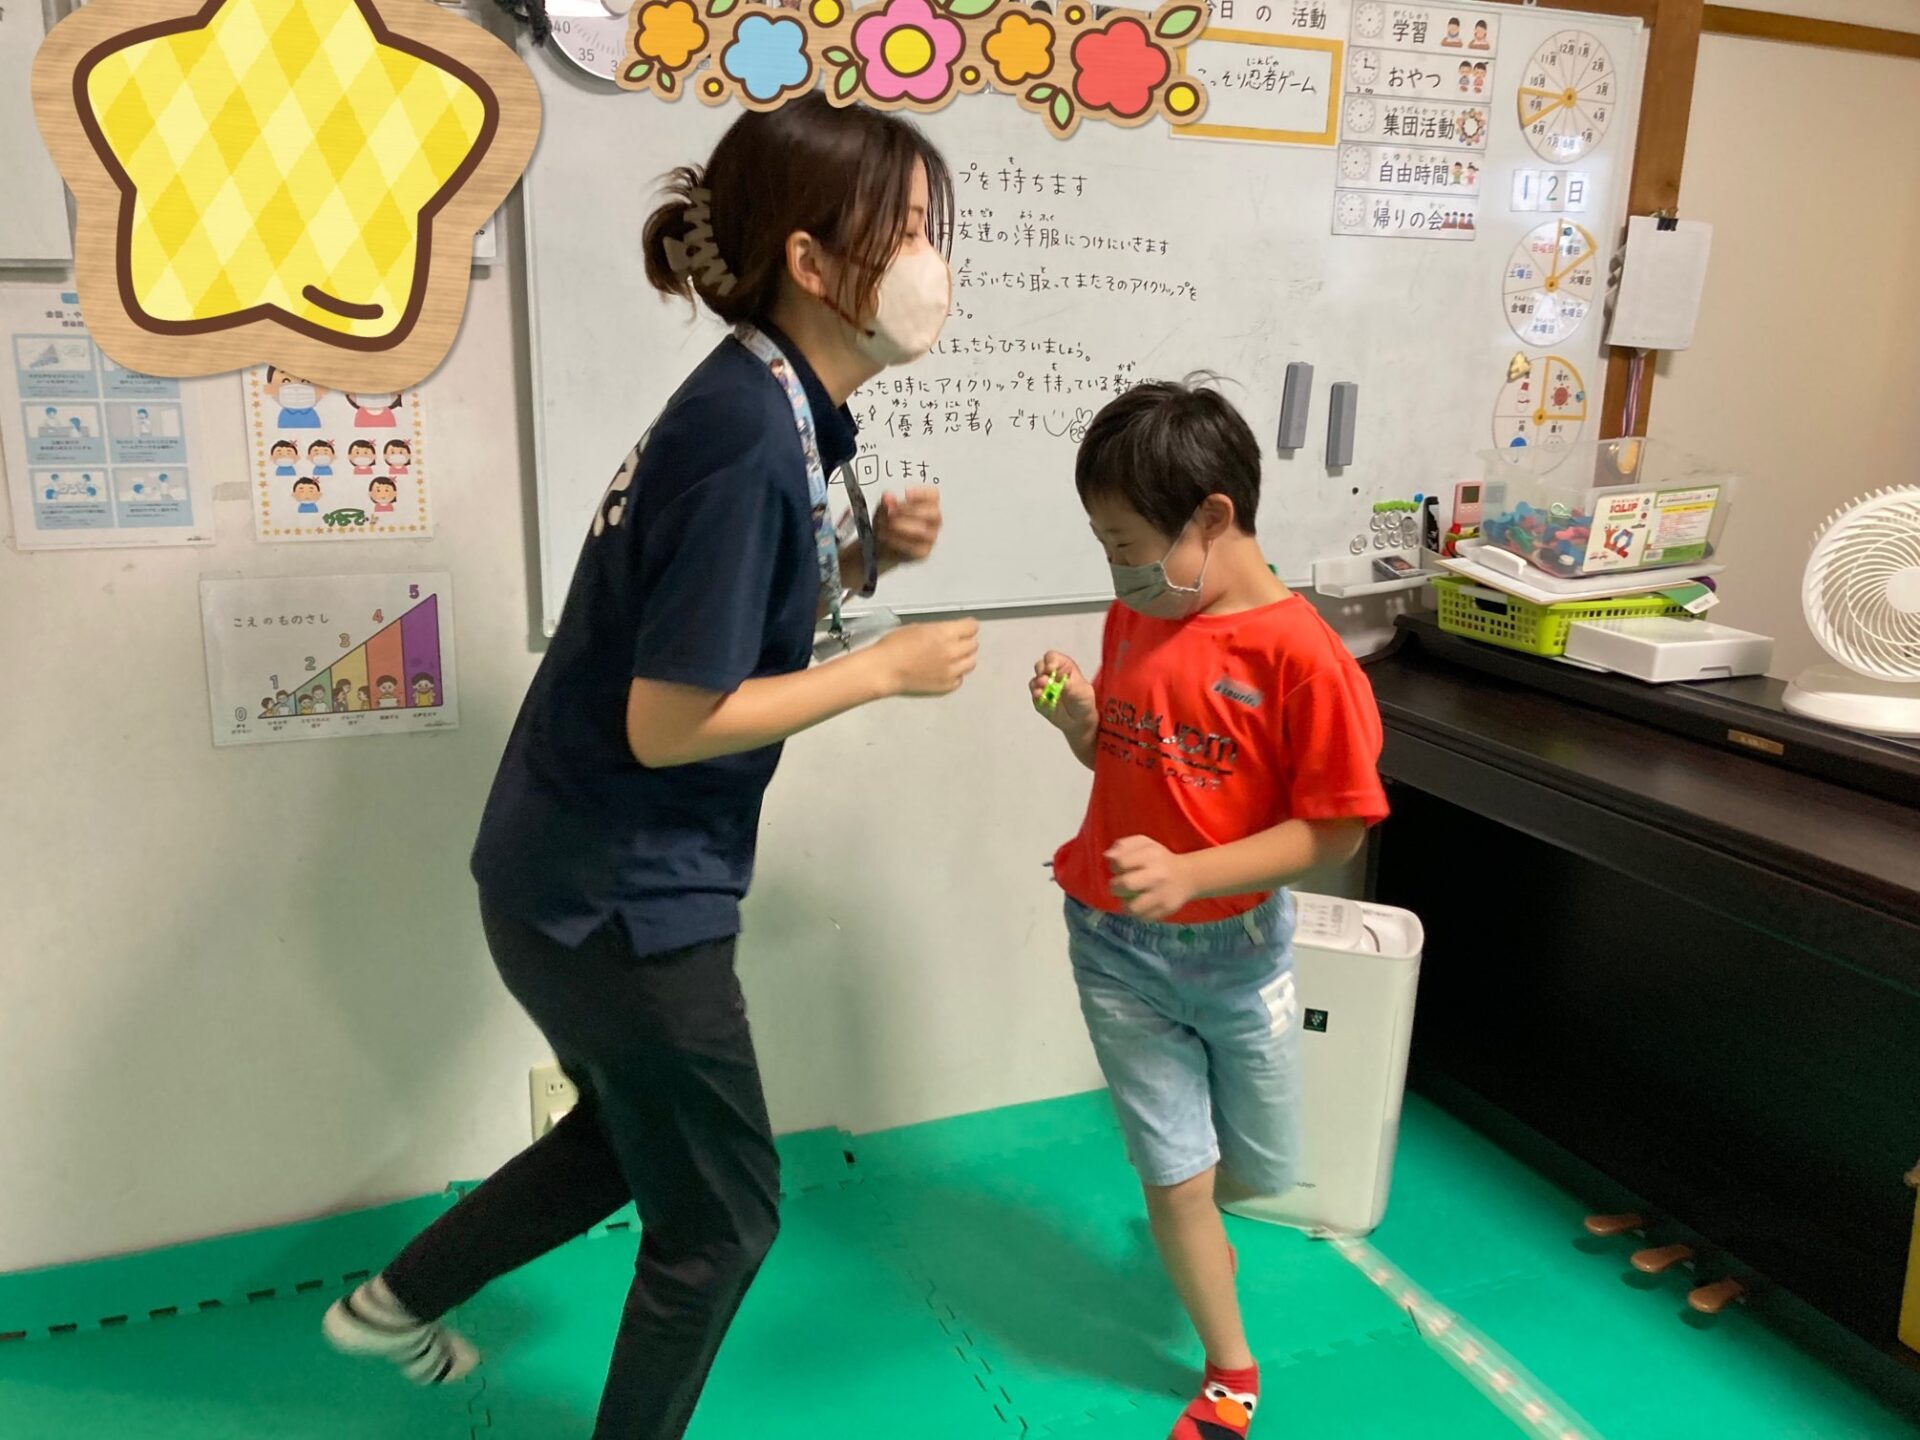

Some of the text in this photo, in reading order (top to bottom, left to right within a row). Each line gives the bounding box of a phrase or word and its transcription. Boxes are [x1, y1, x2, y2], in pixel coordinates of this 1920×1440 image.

[1256, 5, 1272, 22] の
[1292, 7, 1327, 30] 活動
[1392, 20, 1428, 43] 学習
[578, 48, 595, 62] 35
[1560, 43, 1575, 55] 12月
[1578, 46, 1589, 58] 1月
[610, 60, 618, 73] 3
[1541, 54, 1556, 66] 11月
[1592, 60, 1604, 72] 2月
[1388, 67, 1441, 88] おやつ
[1530, 76, 1546, 88] 10月
[1596, 85, 1608, 96] 3月
[1593, 110, 1605, 122] 4月
[1383, 113, 1455, 140] 集団活動
[1532, 123, 1545, 135] 8月
[959, 163, 1087, 197] プを持ちます
[1379, 161, 1449, 186] 自由時間
[1373, 207, 1443, 230] 帰りの会
[947, 302, 973, 319] う。
[929, 335, 1090, 362] しまったらひろいましょう。
[1008, 409, 1038, 431] です
[409, 585, 420, 599] 5
[372, 609, 384, 623] 4
[339, 633, 350, 648] 3
[304, 657, 316, 671] 2
[269, 675, 279, 689] 1
